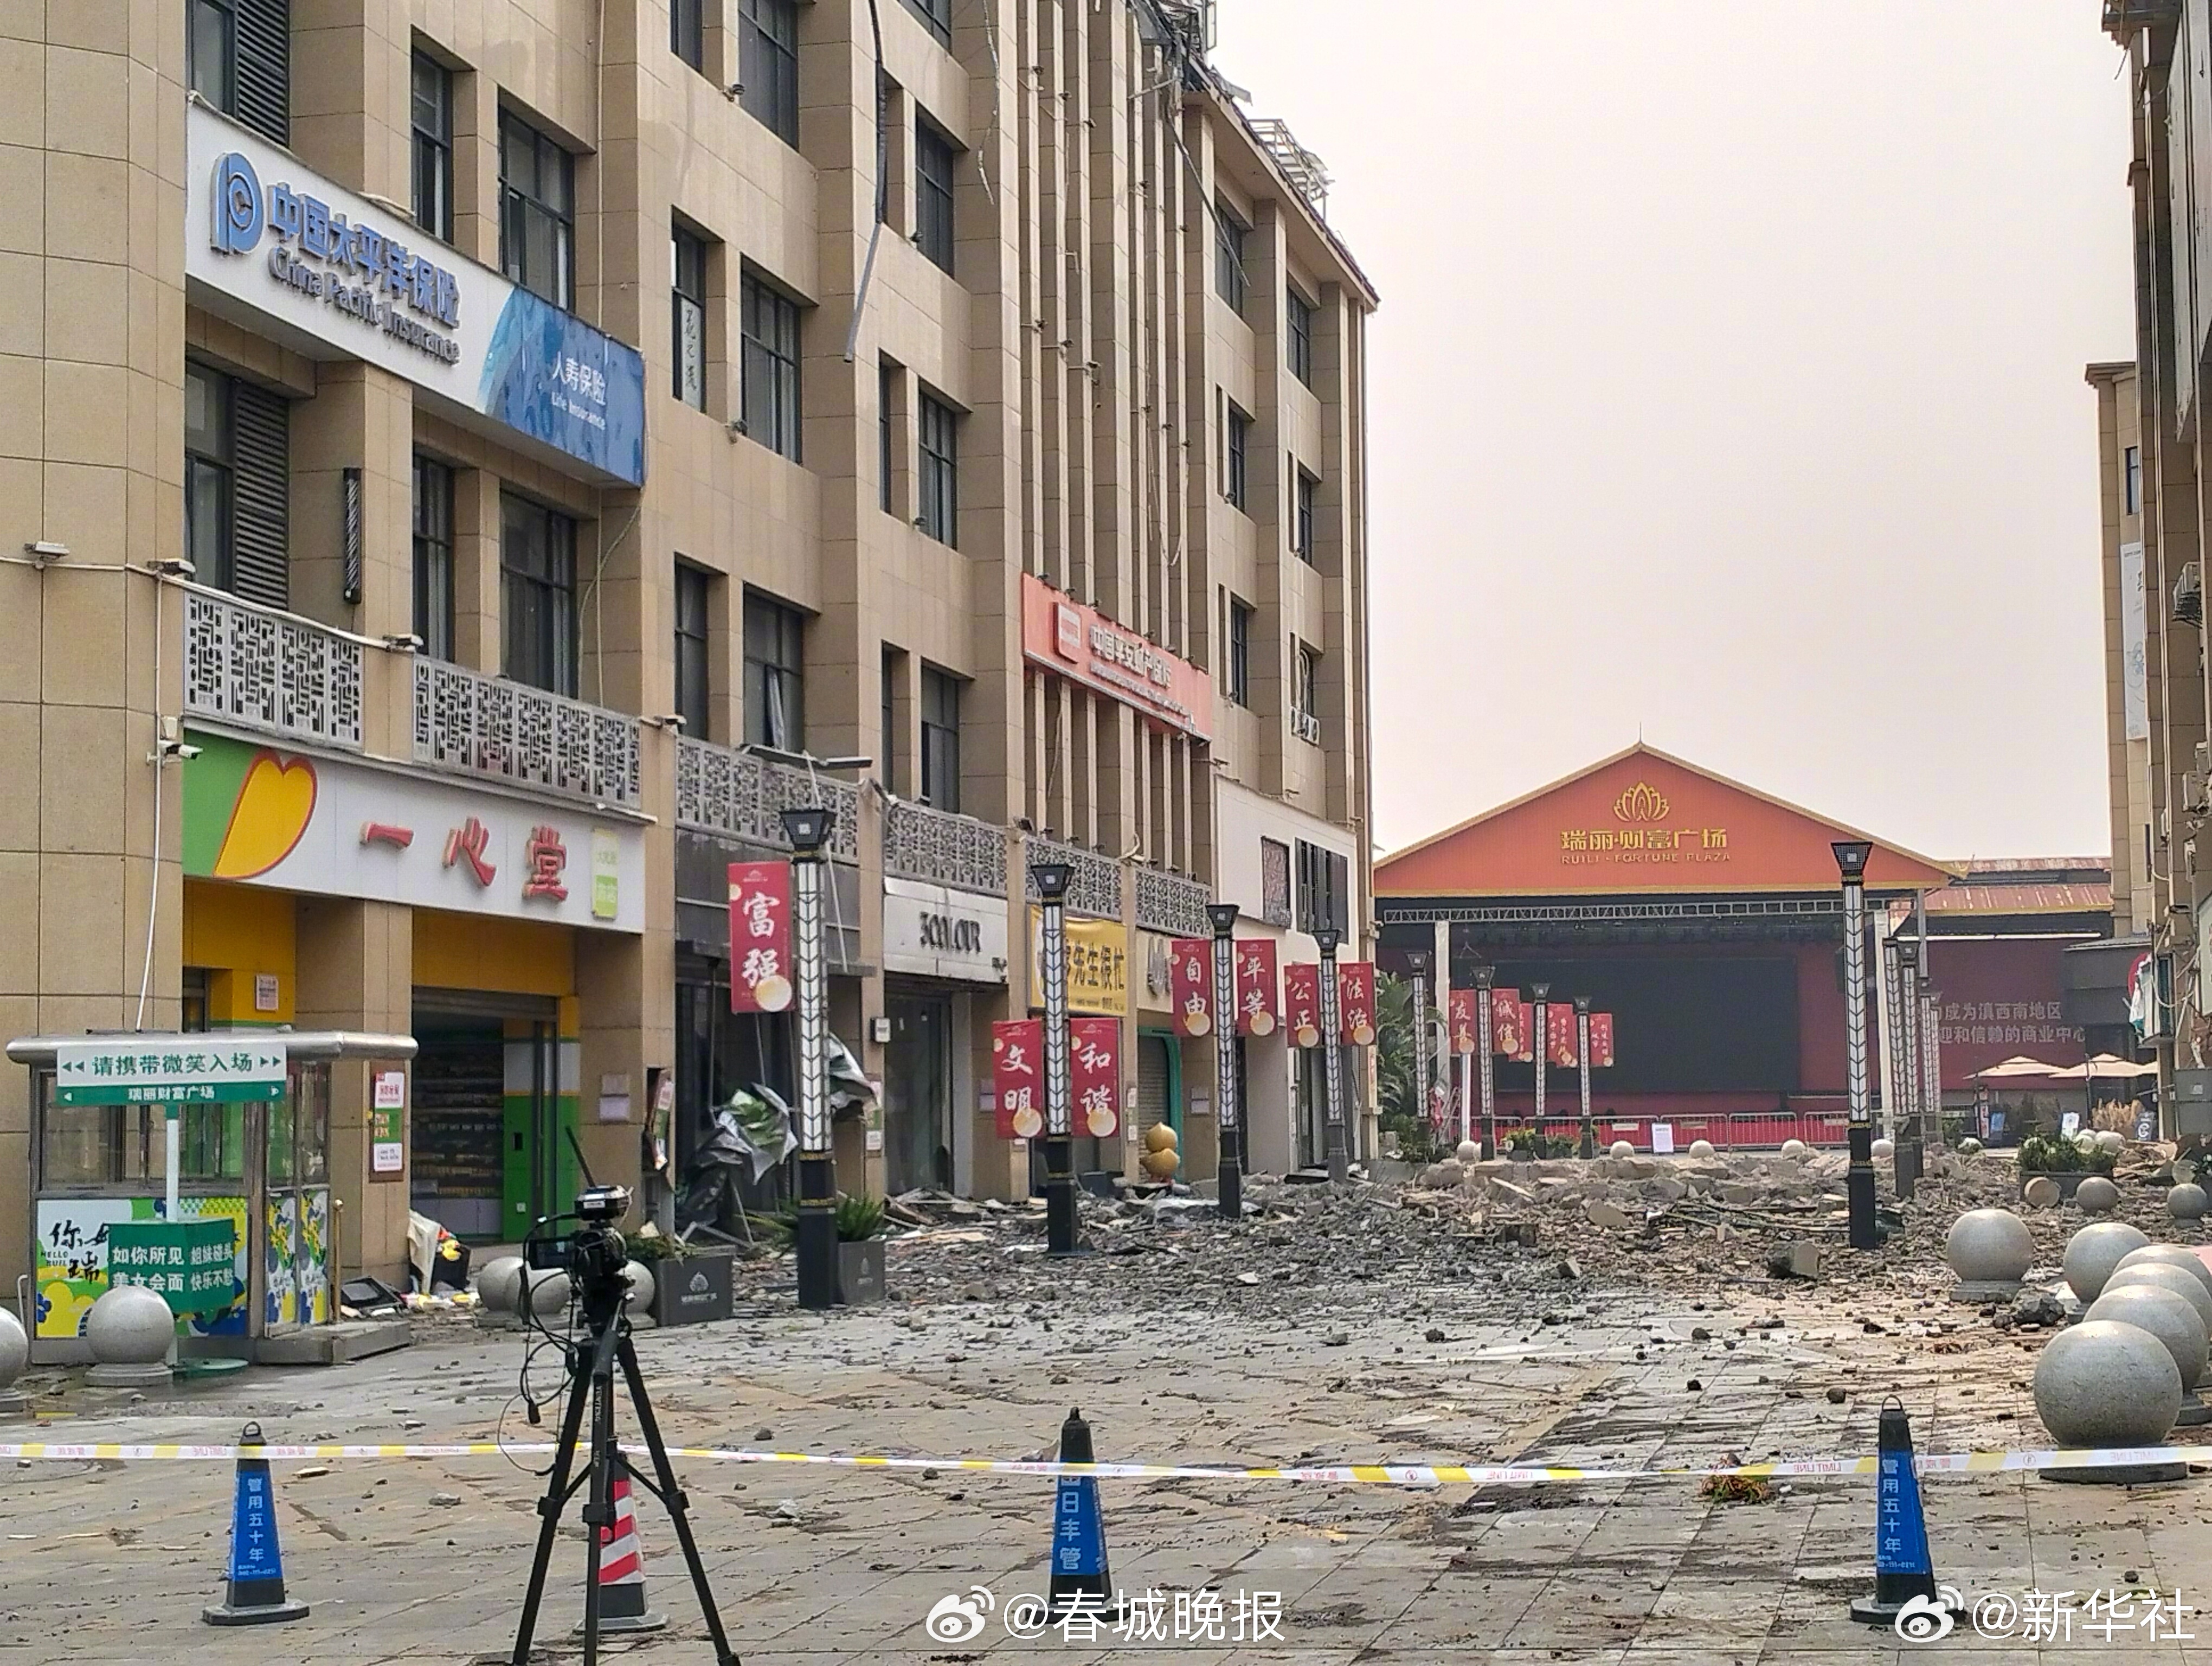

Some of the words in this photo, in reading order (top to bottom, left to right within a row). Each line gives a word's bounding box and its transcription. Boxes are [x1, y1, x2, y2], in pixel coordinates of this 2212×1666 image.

[267, 182, 460, 329] 中国太平洋保险
[268, 246, 324, 297] China
[324, 271, 381, 326] Pacific
[381, 301, 461, 366] Insurance
[552, 351, 606, 405] 人寿保险
[359, 816, 569, 902] 一心堂
[1561, 854, 1599, 864] RUILI
[1614, 853, 1679, 863] FORTUNE
[1686, 852, 1731, 861] PLAZA
[742, 891, 780, 990] 富强
[1184, 956, 1207, 1015] 自由
[1241, 956, 1266, 1021] 平等
[1291, 981, 1315, 1031] 公正
[1347, 978, 1367, 1030] 法治
[1496, 999, 1516, 1042] 诚信
[92, 1052, 253, 1076] 请携带微笑入场
[1001, 1044, 1033, 1113] 文明
[1078, 1042, 1113, 1114] 和谐
[128, 1086, 215, 1101] 瑞丽财富广场
[112, 1246, 185, 1265] 如你所见
[190, 1242, 233, 1265] 姐妹碰头
[112, 1272, 185, 1292] 美女会面
[247, 1477, 265, 1562] 管用五十年
[1882, 1459, 1901, 1553] 管用五十年
